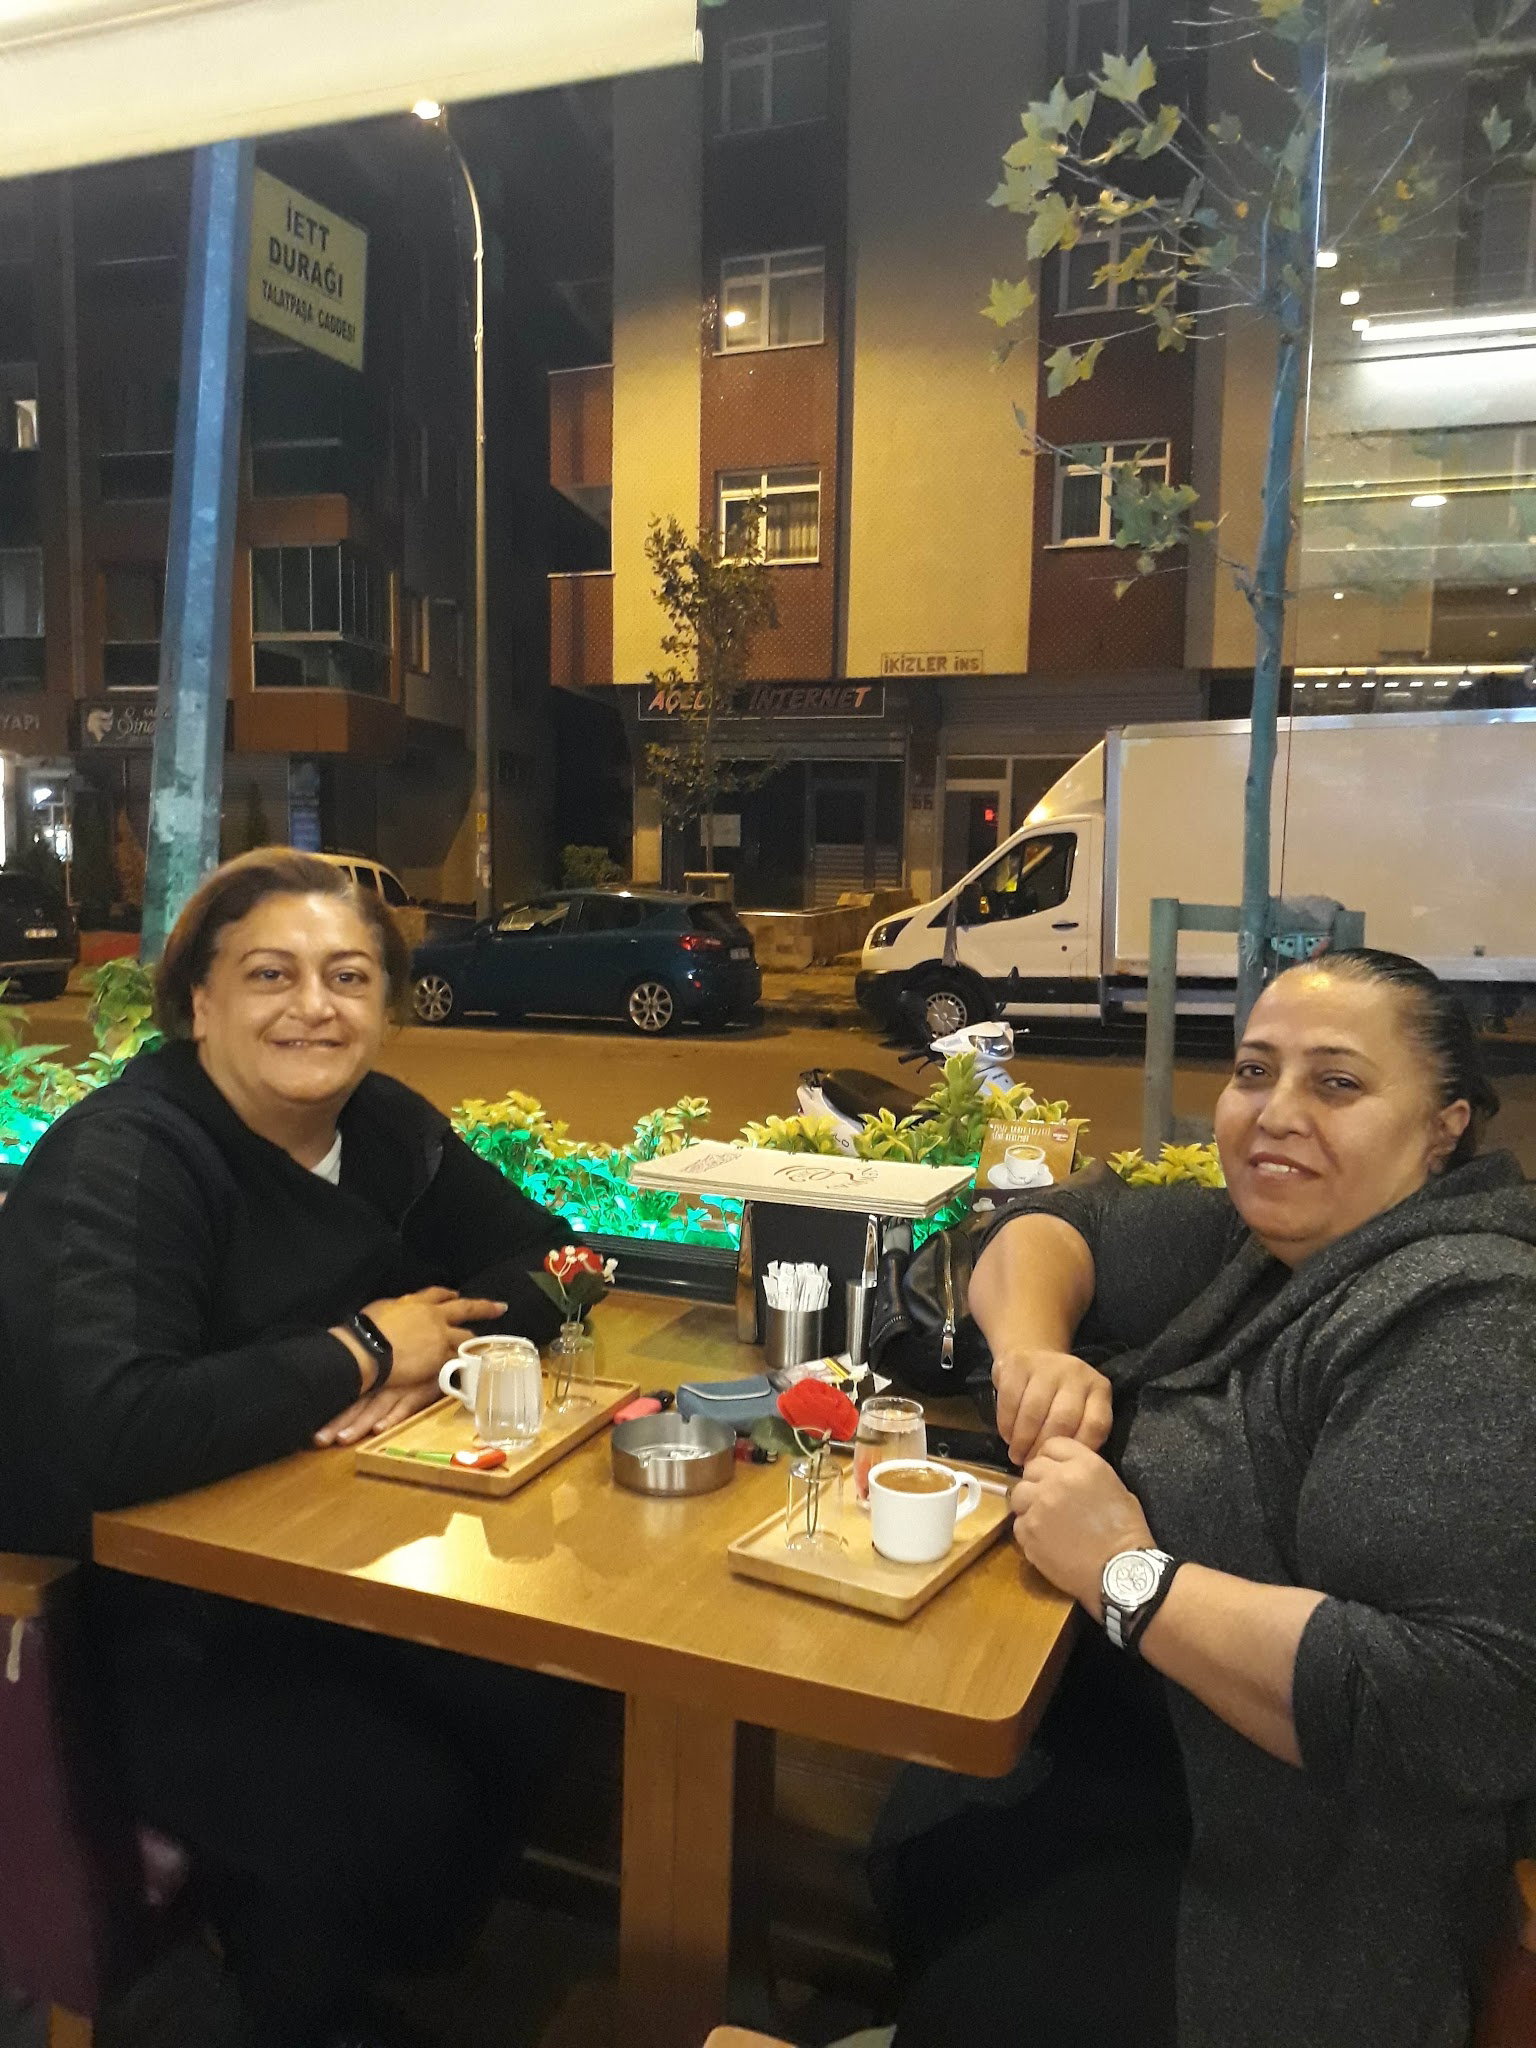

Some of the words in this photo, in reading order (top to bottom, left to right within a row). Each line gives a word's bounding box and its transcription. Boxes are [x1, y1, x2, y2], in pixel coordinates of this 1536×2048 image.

[286, 200, 330, 251] İETT
[269, 236, 344, 298] DURAĞI
[884, 655, 947, 674] İKİZLER
